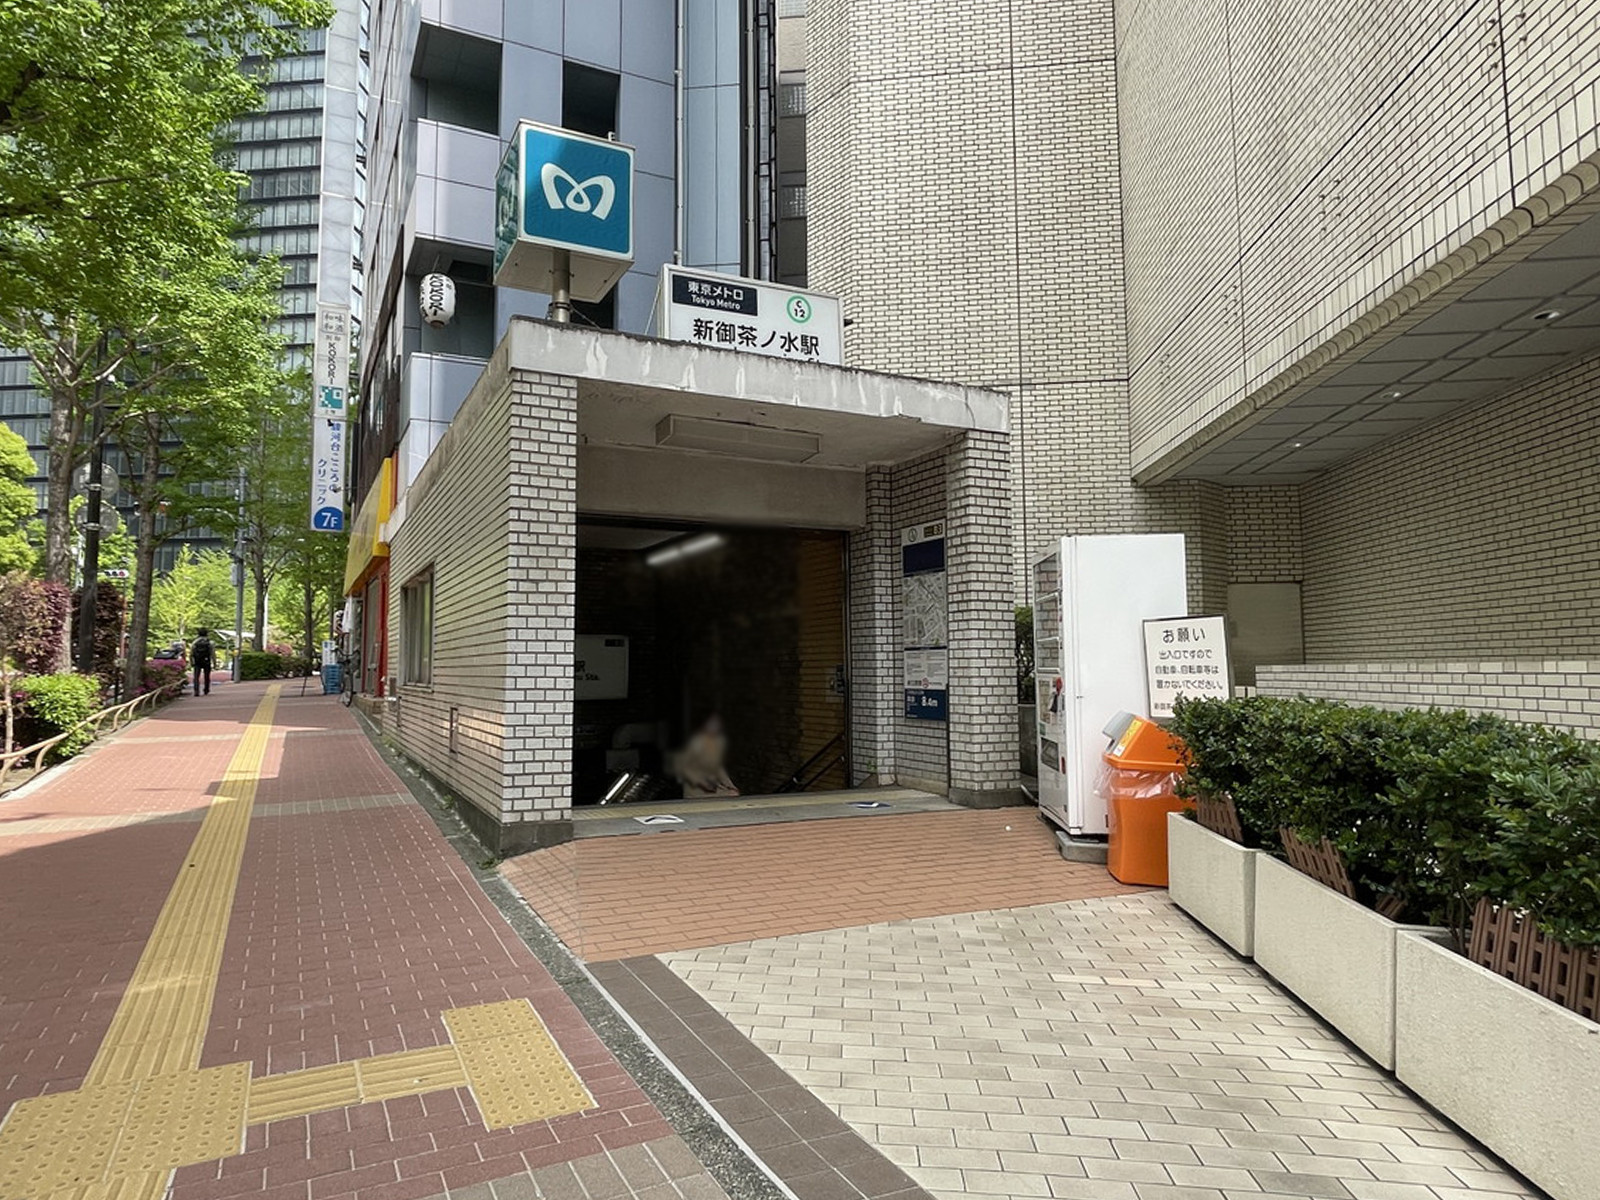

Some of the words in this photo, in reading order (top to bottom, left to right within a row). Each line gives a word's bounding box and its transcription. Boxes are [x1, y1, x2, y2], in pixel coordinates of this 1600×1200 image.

[429, 274, 446, 316] KOKORI
[687, 280, 744, 300] 東京メトロ
[691, 294, 716, 308] Tokyo
[716, 298, 741, 311] Metro
[796, 300, 803, 309] C
[793, 308, 806, 318] 12
[693, 317, 820, 356] 新御茶ノ水駅
[327, 341, 336, 385] KOKORI
[316, 458, 328, 505] クリニック
[321, 512, 338, 528] 7F
[1162, 626, 1206, 643] お願い
[1158, 649, 1213, 660] 出入口ですので
